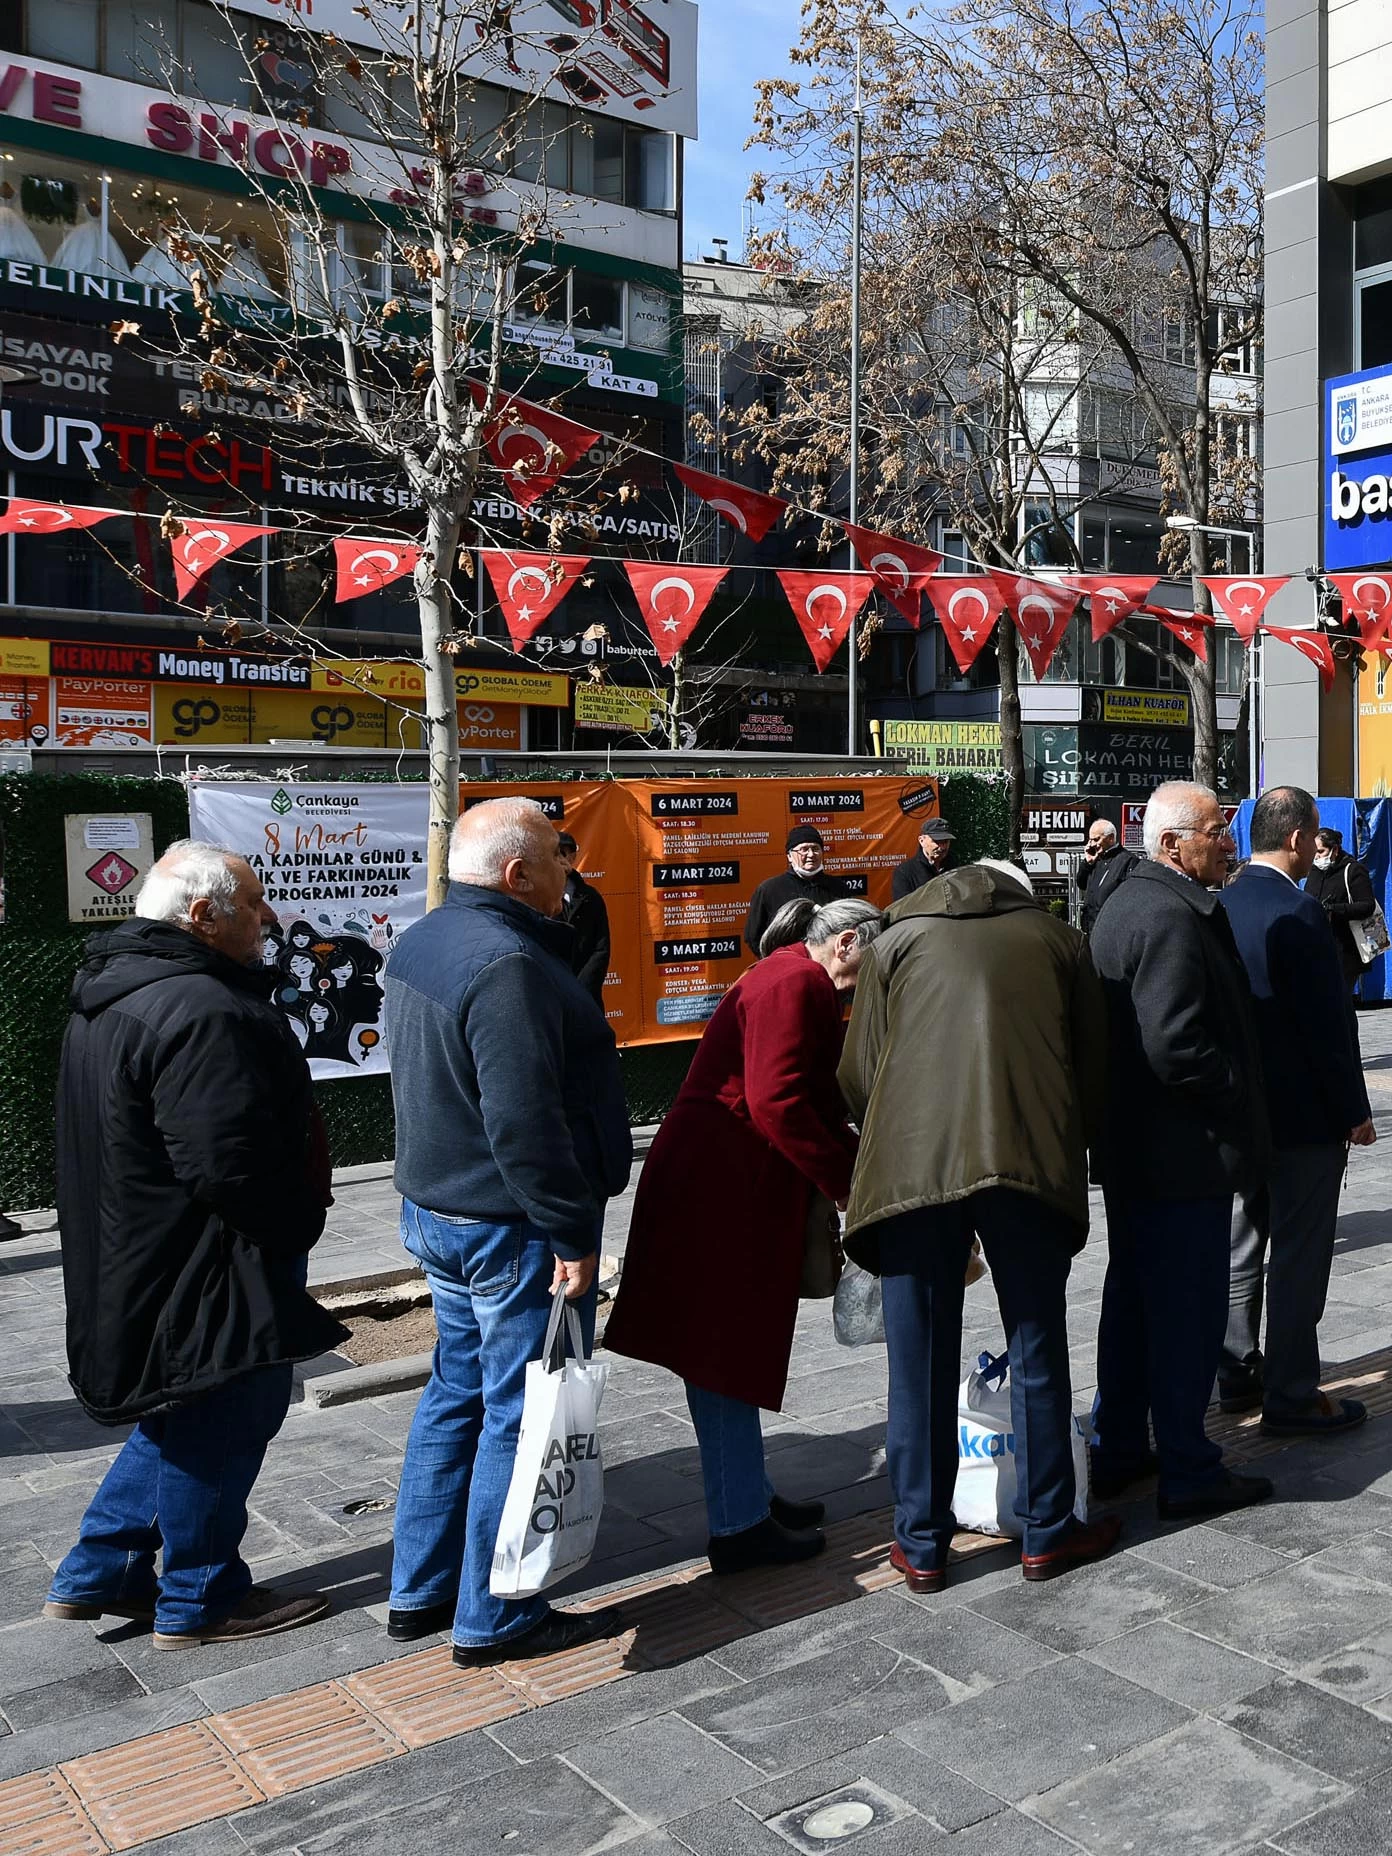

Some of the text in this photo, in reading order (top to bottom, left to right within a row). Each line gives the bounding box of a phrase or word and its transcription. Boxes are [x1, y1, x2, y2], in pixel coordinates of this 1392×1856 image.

[145, 102, 351, 187] SHOP
[0, 260, 182, 314] ELINLIK
[560, 353, 580, 367] 425
[583, 357, 595, 369] 21
[601, 375, 646, 394] KAT 4
[1361, 393, 1390, 406] ANKARA
[282, 473, 377, 504] TEKNİK
[472, 498, 545, 520] YEDEK
[52, 646, 306, 684] KERVAN'S Money Transfer
[62, 678, 146, 693] PayPorter
[389, 670, 422, 690] ria
[481, 676, 552, 688] GLOBAL ÖDEME
[1144, 695, 1185, 710] KUAFÖR
[748, 713, 785, 724] ERKEK
[886, 722, 952, 745] LOKMAN
[1045, 749, 1151, 768] LOKMAN
[1042, 769, 1120, 789] ŞİFALI
[296, 794, 360, 808] Çankaya
[658, 797, 732, 809] 6 MART 2024
[792, 795, 861, 807] 20 MART 2024
[305, 808, 352, 816] BELEDİYESİ
[1029, 810, 1084, 829] HEKİM
[264, 821, 368, 855] 8 Mart
[271, 848, 423, 868] KADINLAR GÜNÜ &
[282, 867, 411, 884] VE FARKINDALIK
[660, 866, 733, 880] 7 MART 2024
[92, 894, 135, 906] ATEŞLE
[268, 884, 399, 902] PROGRAMI 2024
[661, 940, 735, 956] 9 MART 2024
[665, 965, 699, 974] SAAT: 19.00
